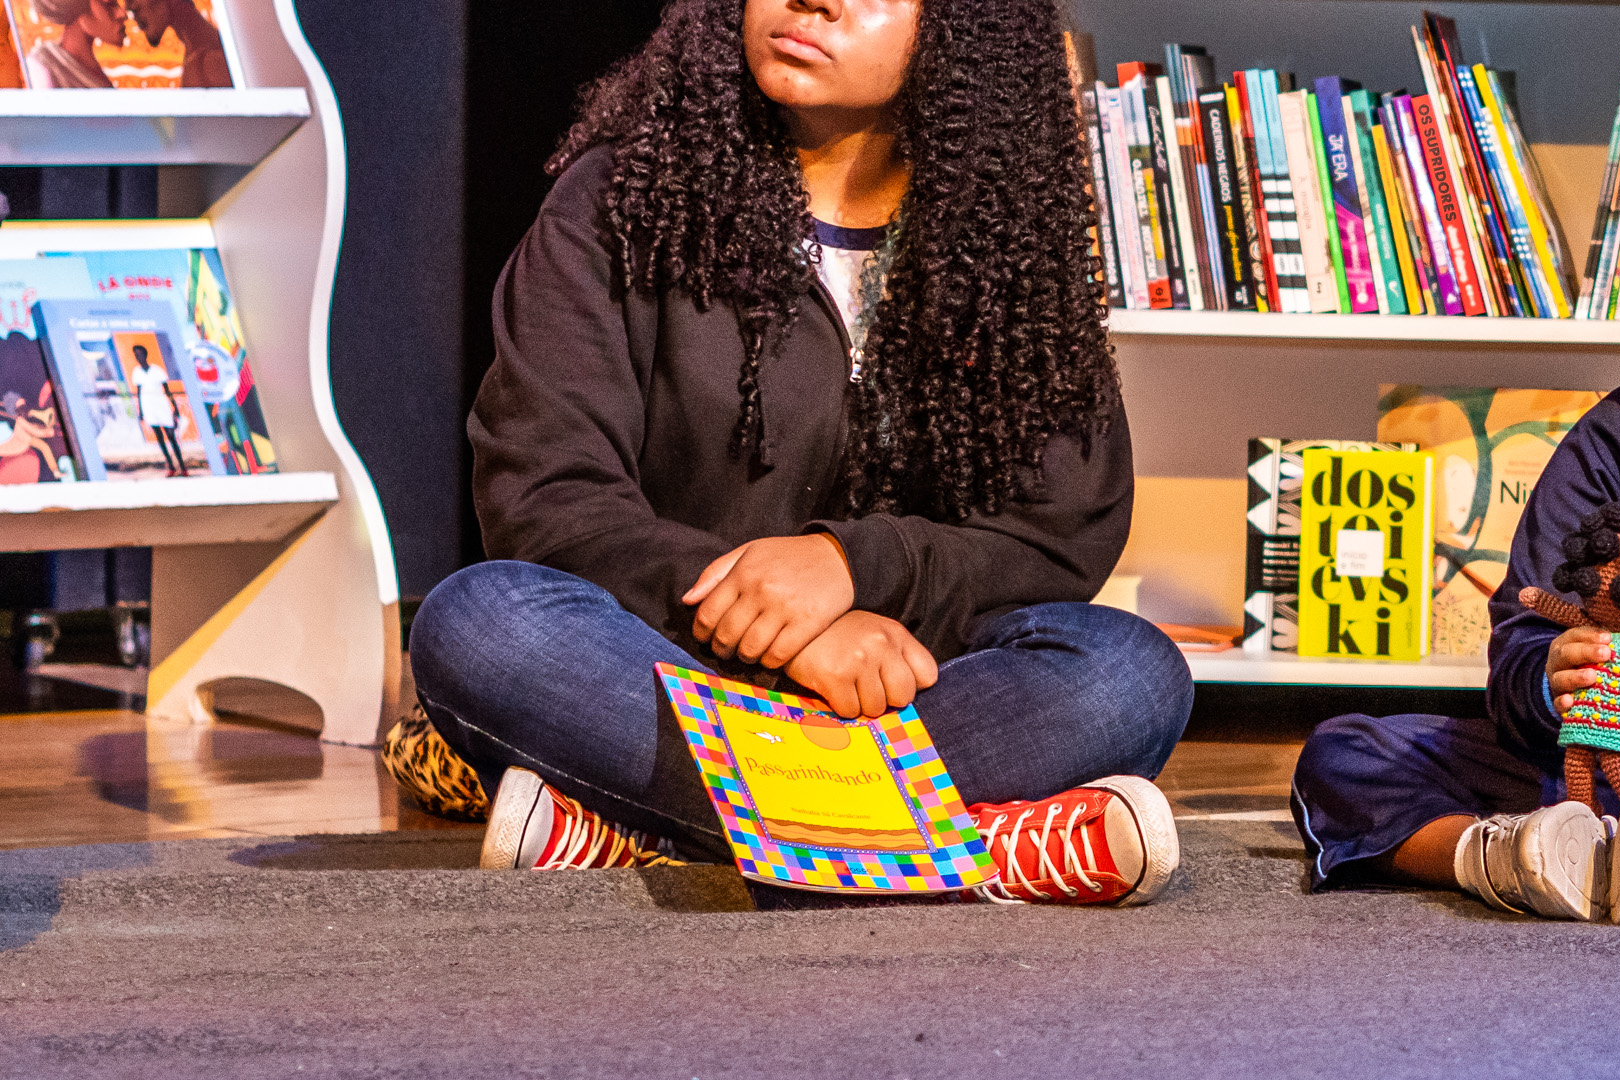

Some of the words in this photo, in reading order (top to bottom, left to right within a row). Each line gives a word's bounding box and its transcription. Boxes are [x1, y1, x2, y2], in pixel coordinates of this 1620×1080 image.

[1417, 103, 1433, 126] OS
[1209, 108, 1226, 162] CADERNOS
[1216, 162, 1232, 203] NEGROS
[1330, 153, 1350, 182] ERA
[1422, 127, 1458, 223] SUPRIDORES
[123, 275, 173, 290] ONDE
[1311, 456, 1416, 510] dos
[744, 756, 882, 787] Passarinhando
